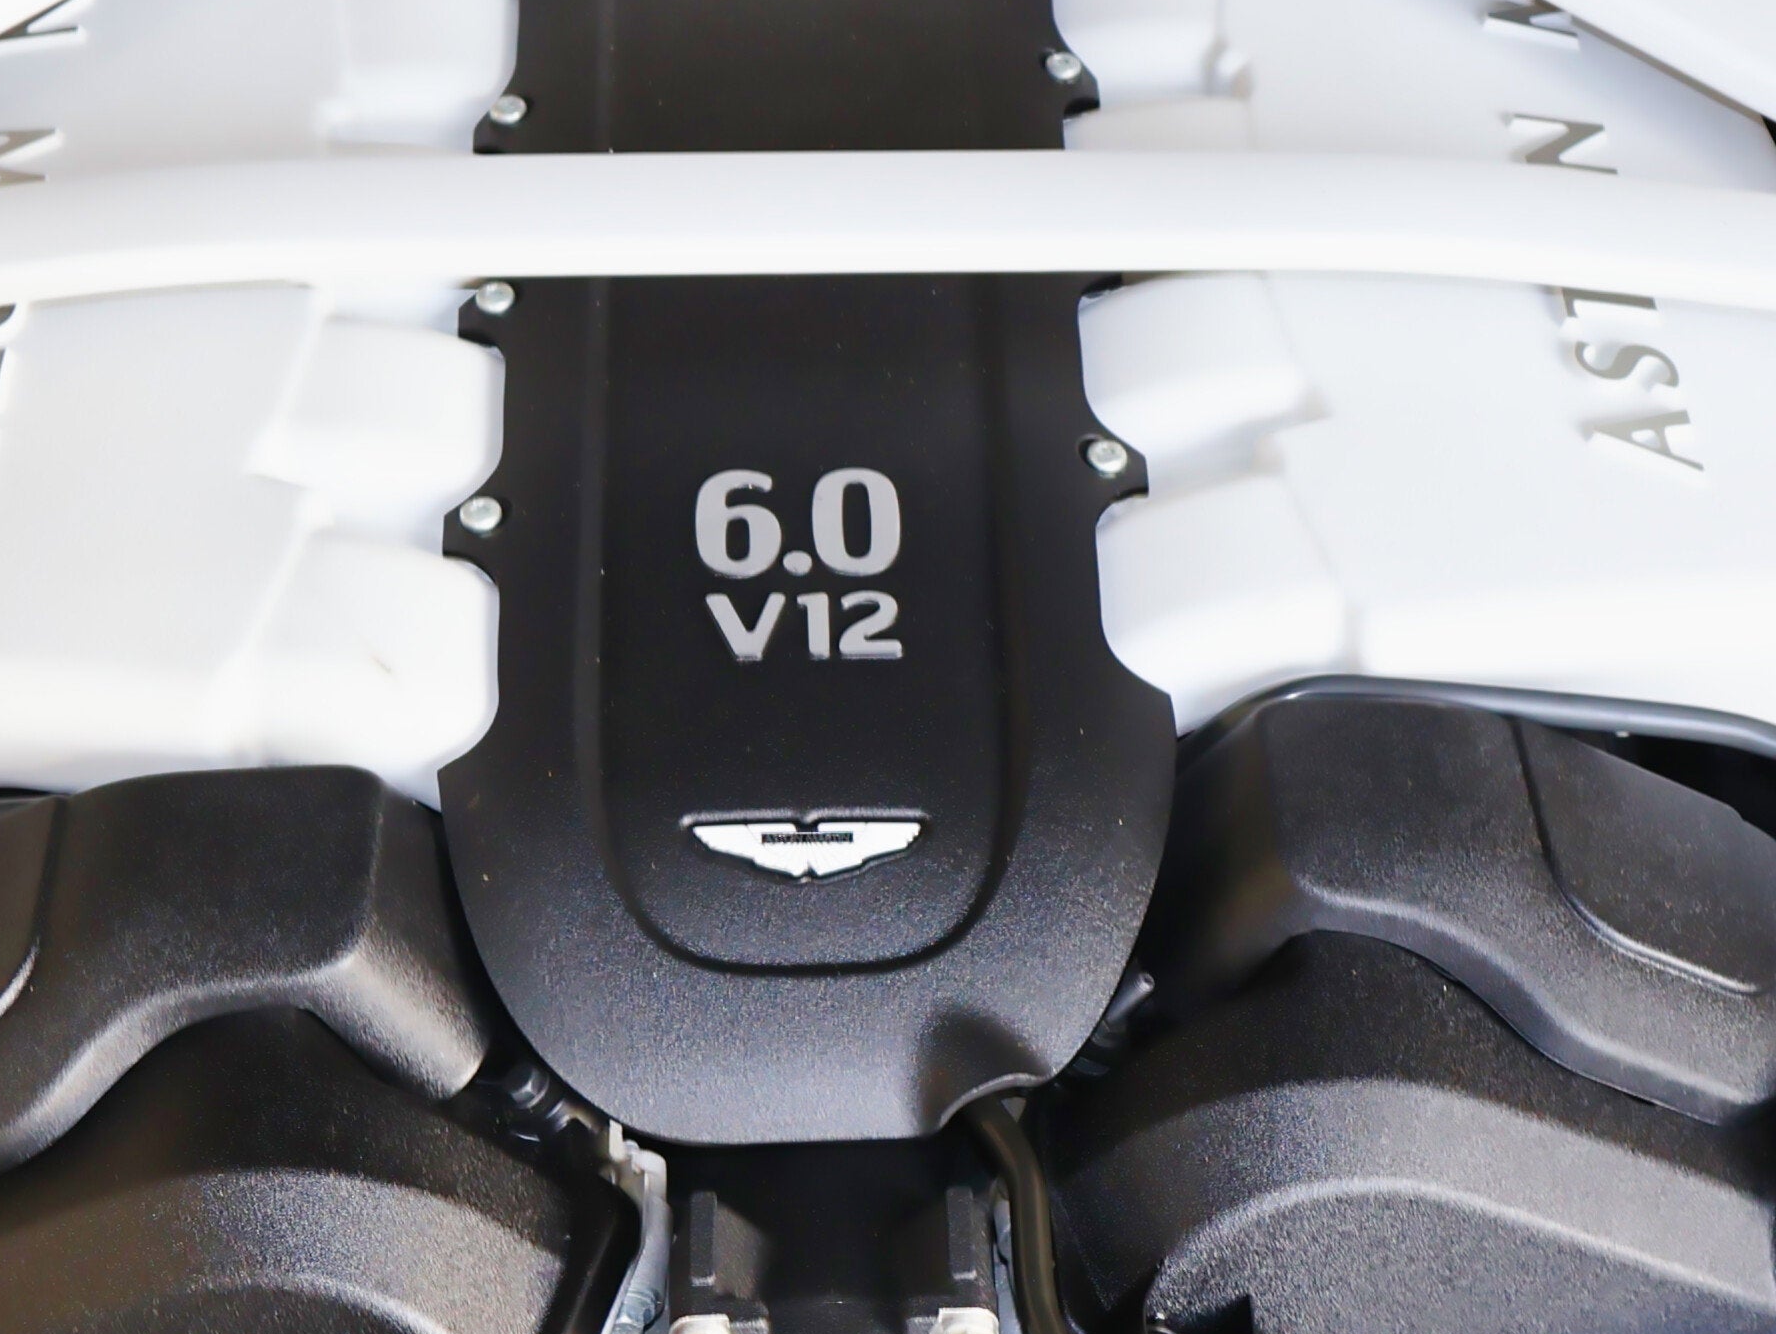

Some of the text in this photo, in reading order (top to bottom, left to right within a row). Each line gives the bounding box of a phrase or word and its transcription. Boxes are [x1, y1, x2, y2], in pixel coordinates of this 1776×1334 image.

[1505, 112, 1705, 471] ASTN
[694, 466, 902, 578] 6.0
[705, 590, 904, 662] V12
